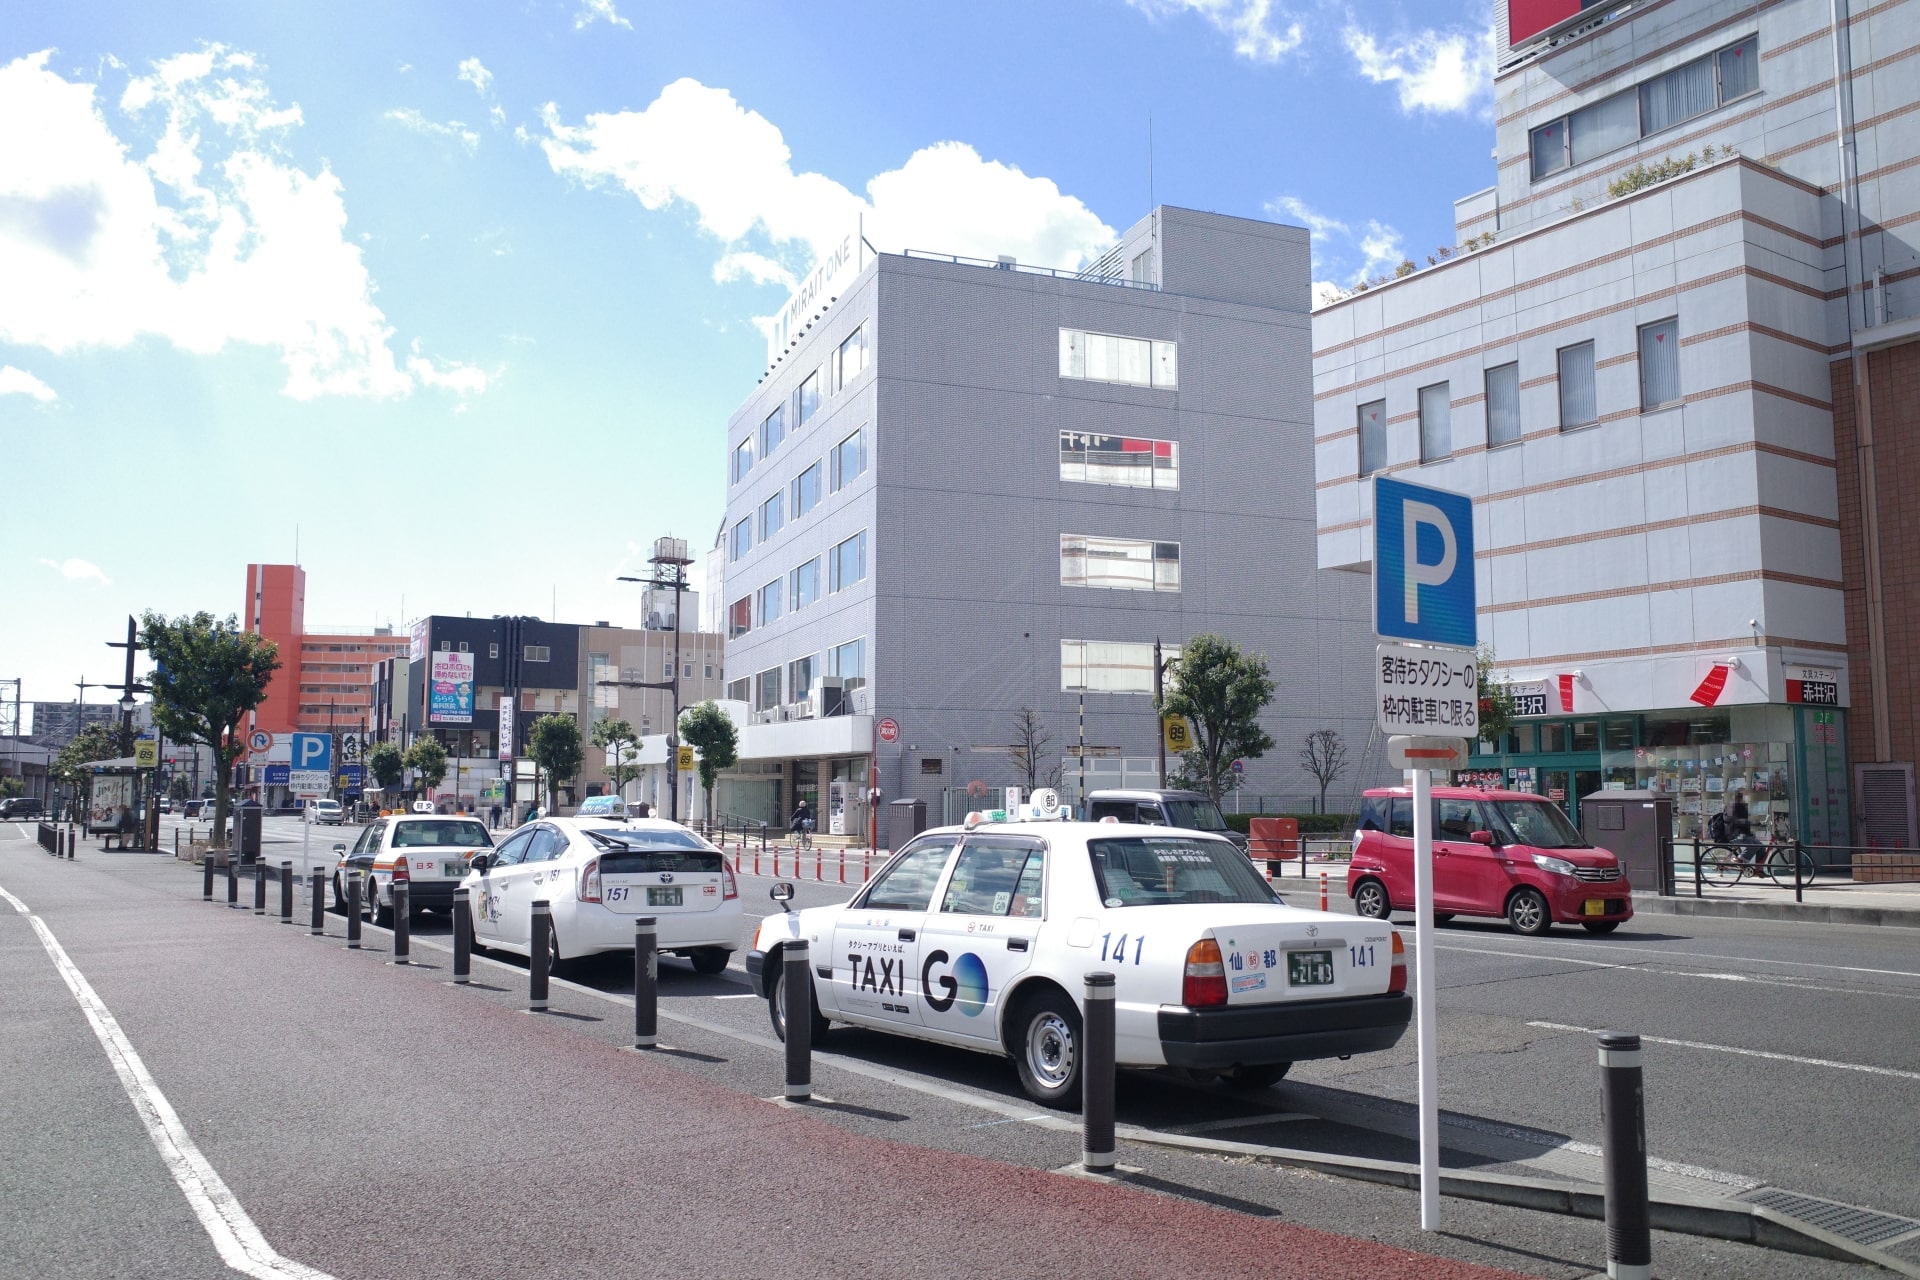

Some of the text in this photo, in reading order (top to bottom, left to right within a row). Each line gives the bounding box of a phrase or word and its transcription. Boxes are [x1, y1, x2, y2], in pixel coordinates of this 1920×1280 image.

[790, 266, 824, 325] MIRAIT
[826, 233, 851, 282] ONE
[1403, 498, 1457, 624] P
[1381, 655, 1475, 689] 客待ちタクシーの
[1802, 670, 1835, 680] 文具ステージ
[1803, 682, 1836, 704] 赤井沢
[1382, 694, 1476, 727] 枠内駐車に限る
[301, 736, 324, 767] P
[606, 888, 629, 901] 151
[978, 923, 995, 933] TAXI
[1101, 931, 1145, 966] 141
[1350, 945, 1375, 968] 141
[847, 953, 904, 997] TAXI
